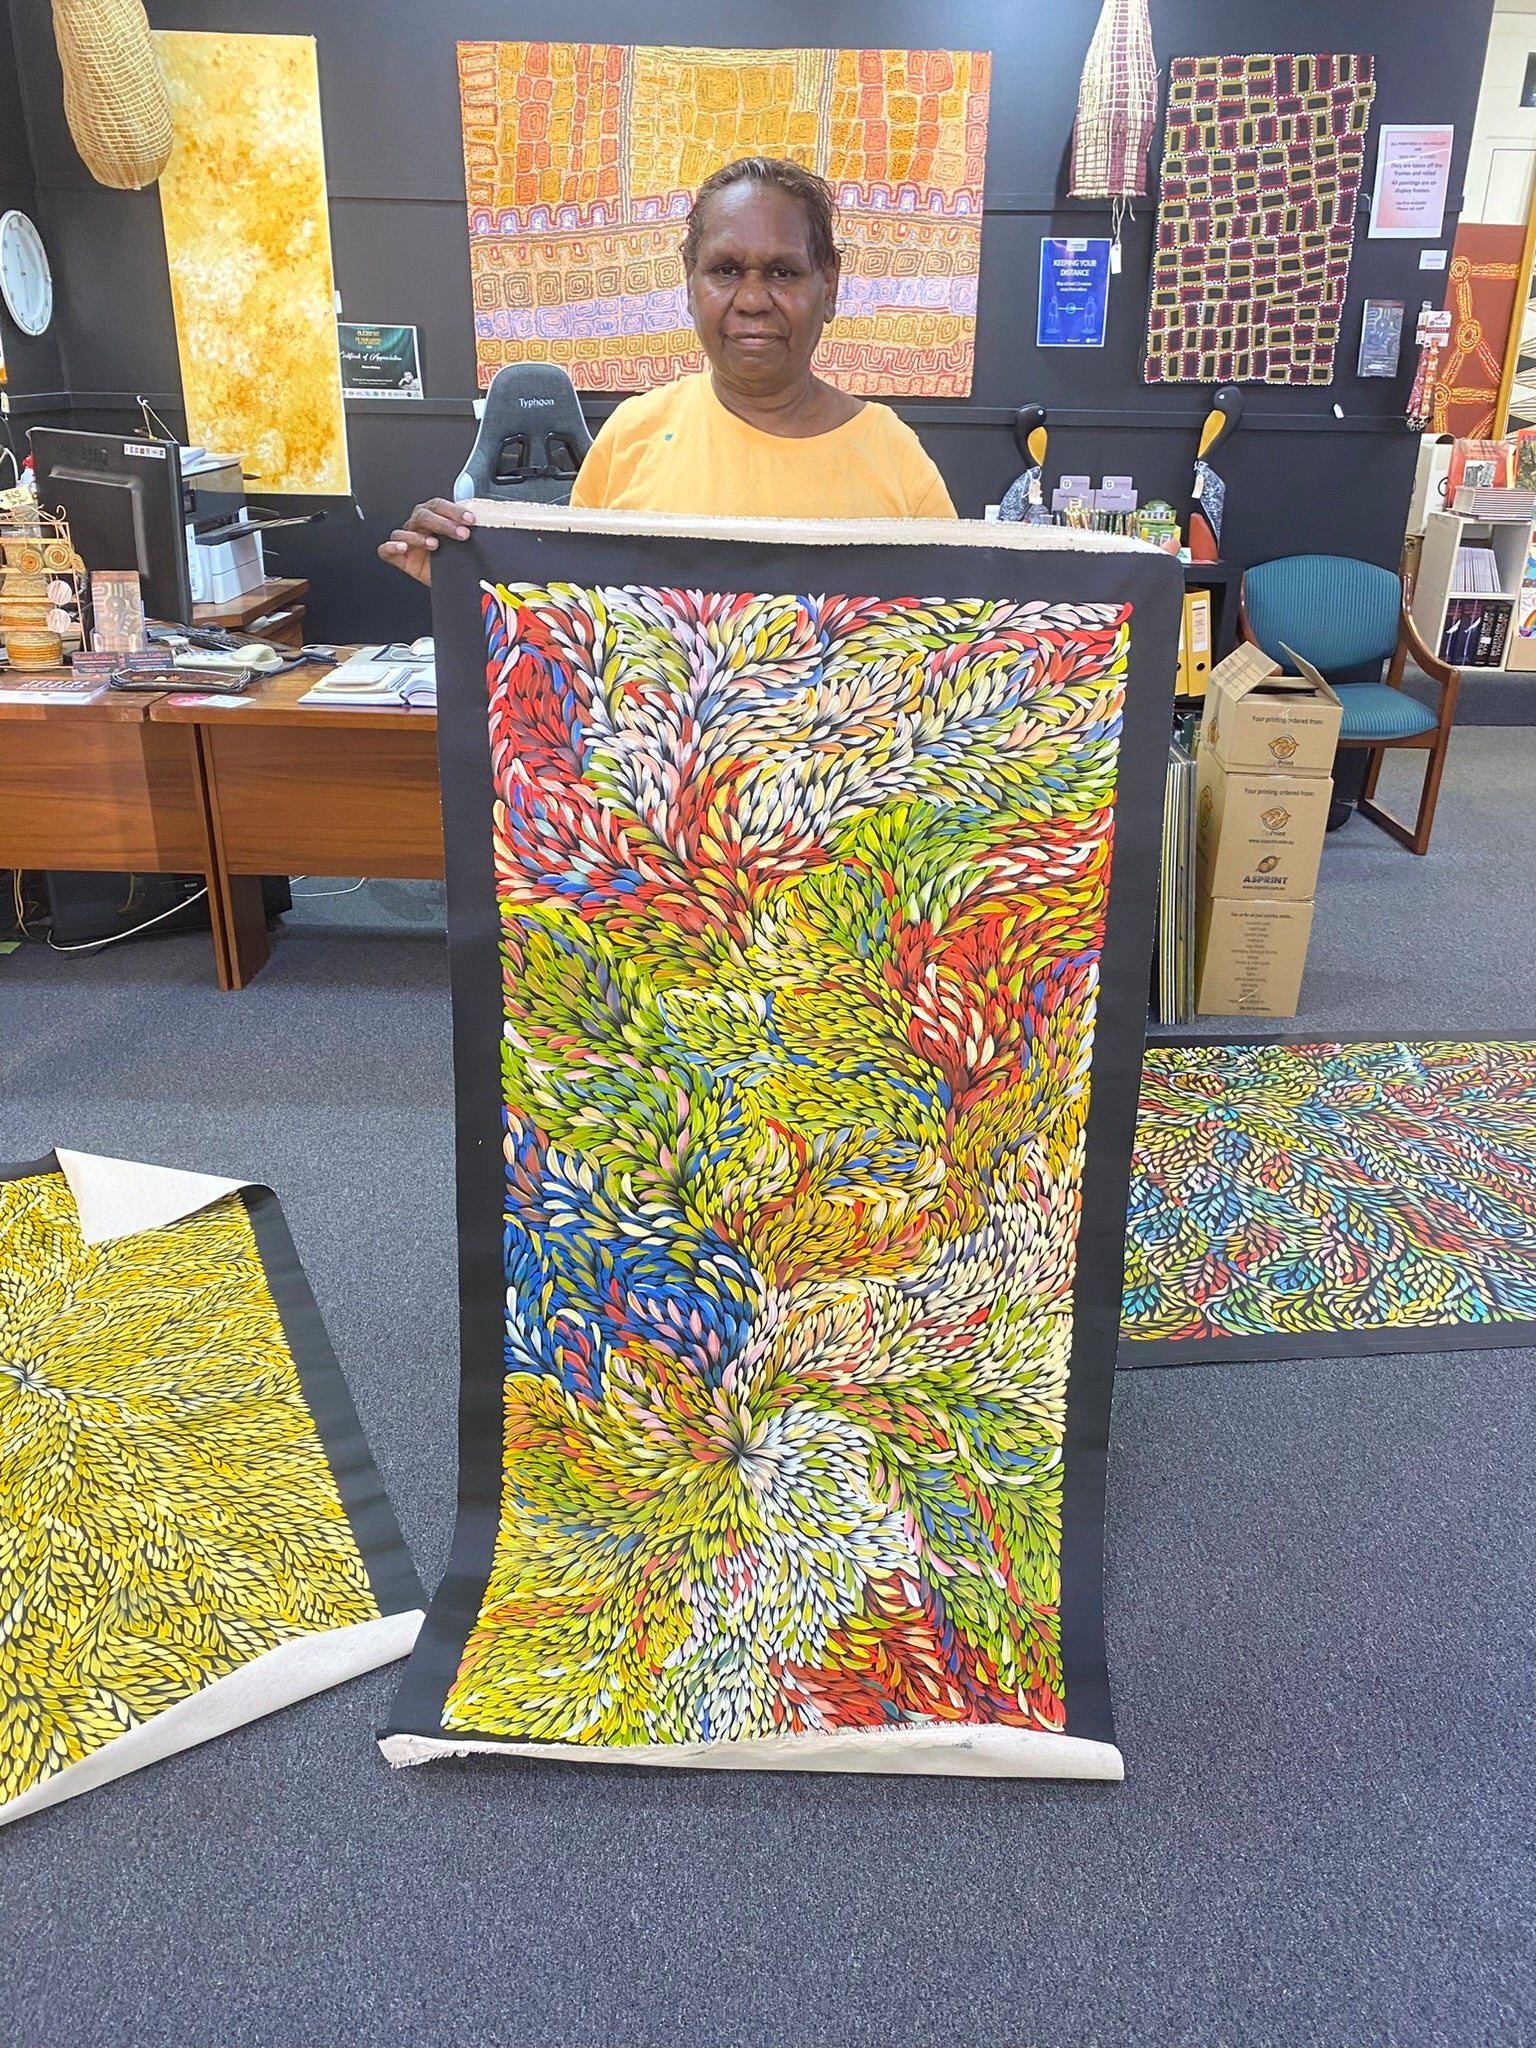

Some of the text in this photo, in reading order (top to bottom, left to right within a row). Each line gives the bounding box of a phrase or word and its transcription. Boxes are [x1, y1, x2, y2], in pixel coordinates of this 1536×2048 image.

[1053, 259, 1097, 267] KEEPING YOUR
[518, 397, 555, 408] Typhoon
[1242, 875, 1288, 885] ASPRINT
